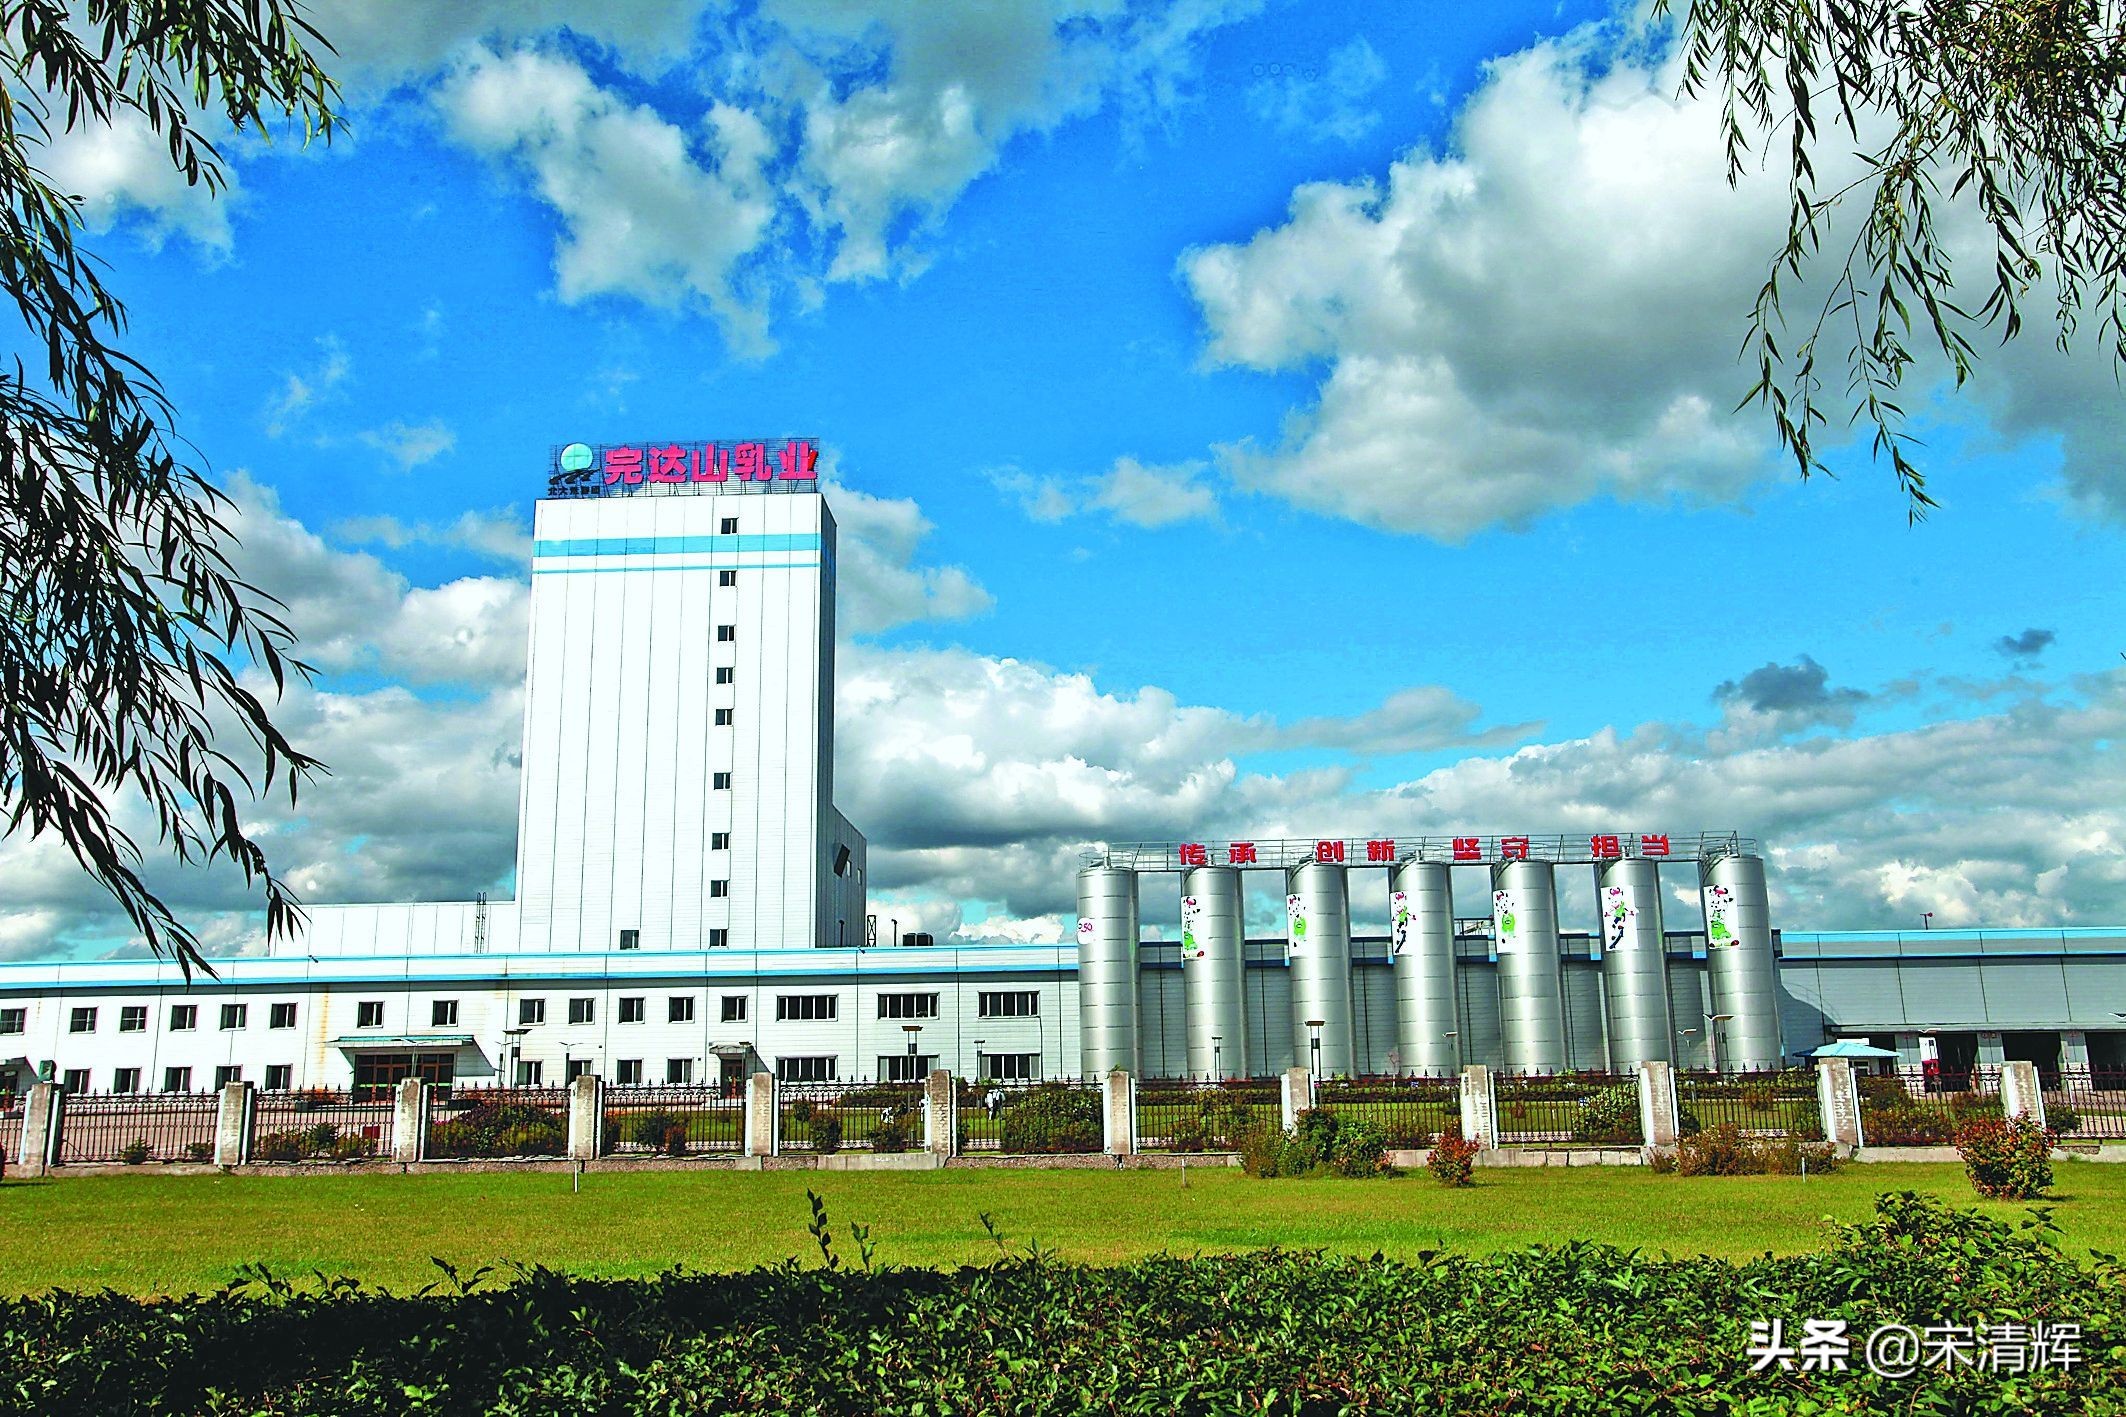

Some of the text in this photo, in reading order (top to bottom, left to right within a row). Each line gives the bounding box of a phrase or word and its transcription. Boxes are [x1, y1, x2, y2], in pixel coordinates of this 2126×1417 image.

[604, 441, 819, 485] 完达山乳业
[1179, 833, 1670, 866] 传承 创新 坚守 担当
